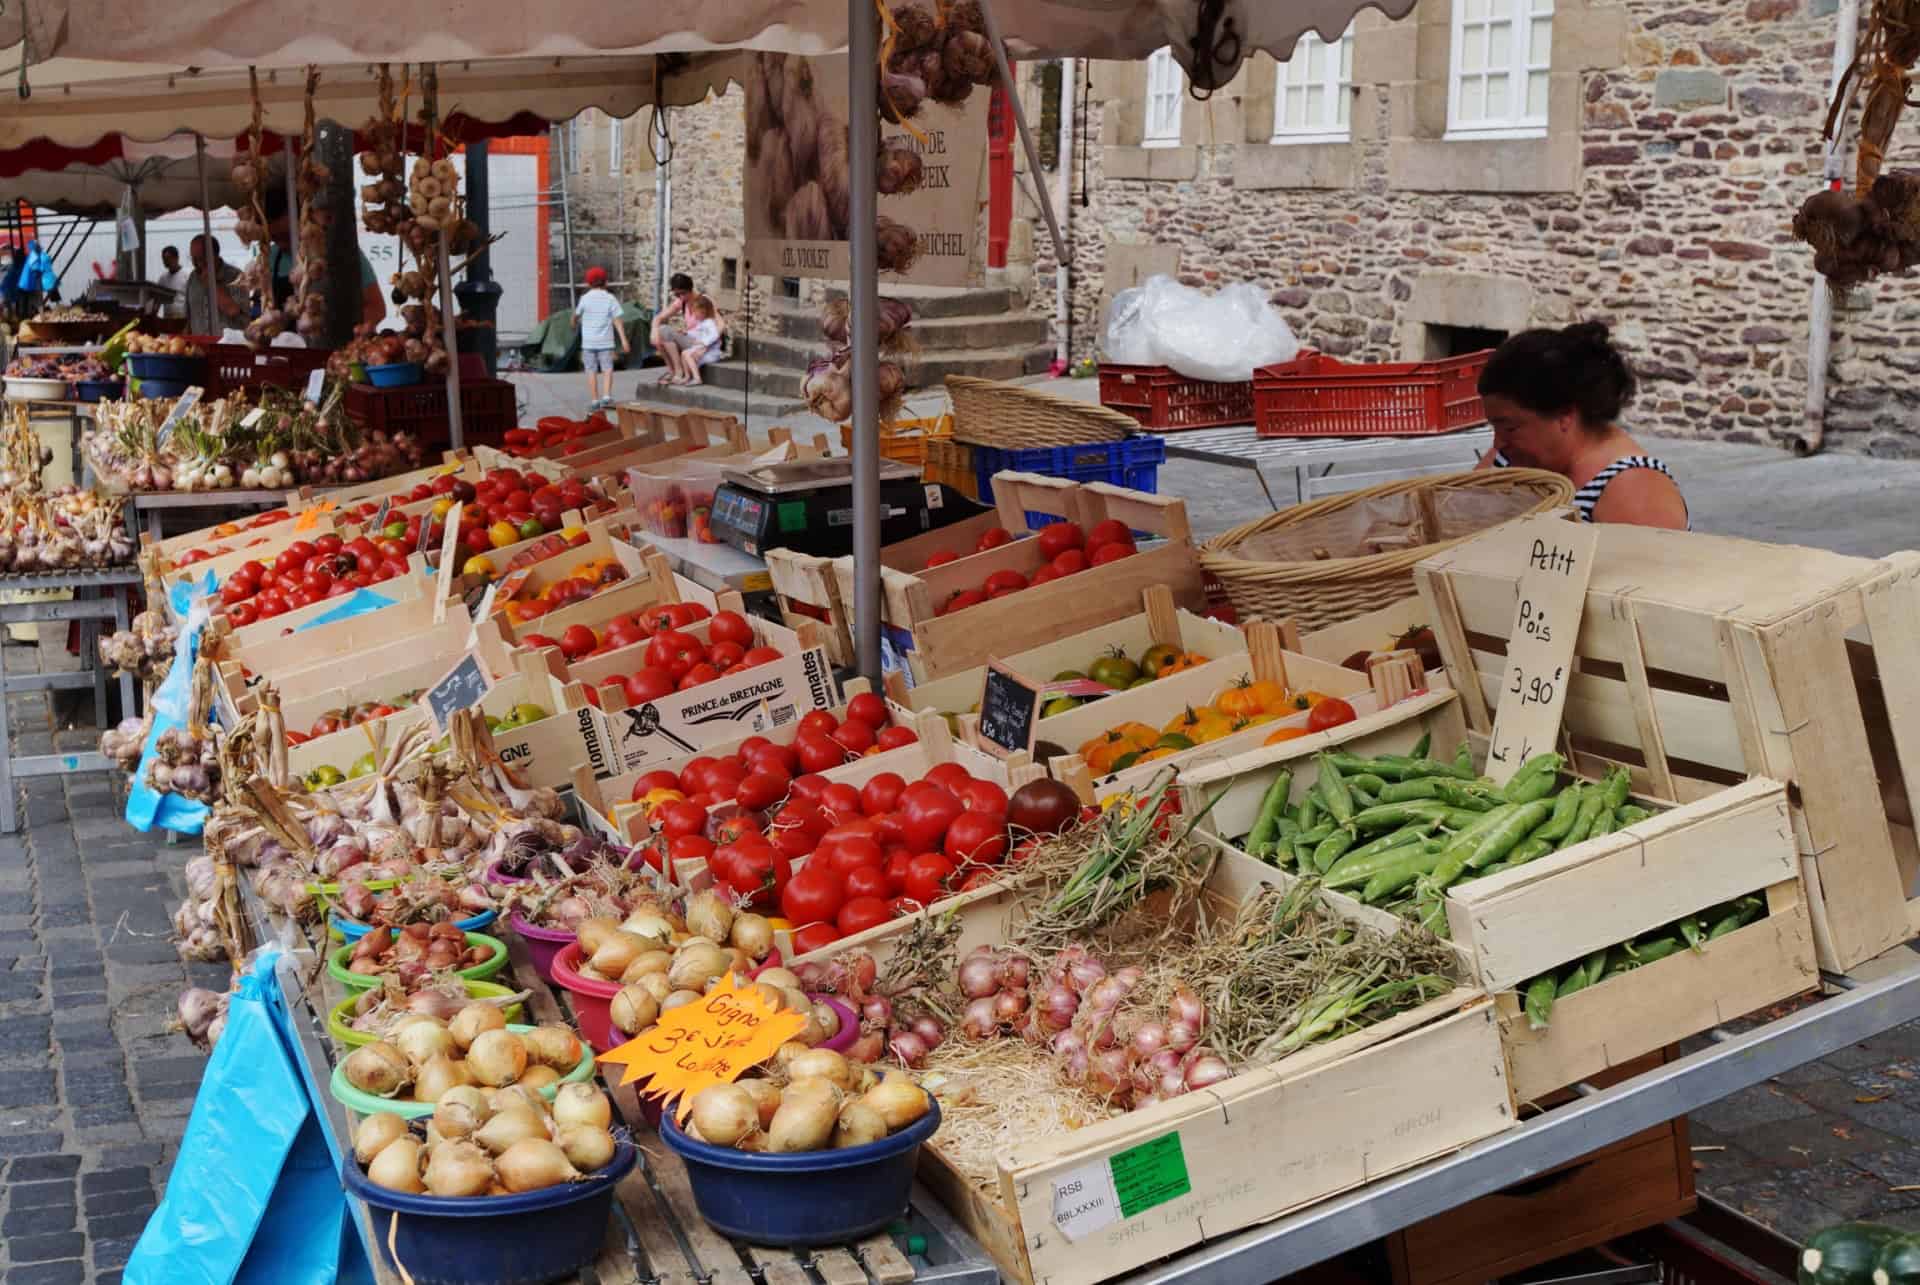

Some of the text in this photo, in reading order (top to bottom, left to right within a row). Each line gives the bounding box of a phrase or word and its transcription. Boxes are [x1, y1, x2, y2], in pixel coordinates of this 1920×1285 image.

[928, 131, 946, 154] DE
[797, 248, 830, 269] VIOLET
[1518, 600, 1552, 642] Pois
[681, 677, 785, 719] PRINCE de BRETAGNE
[499, 742, 532, 763] GNE
